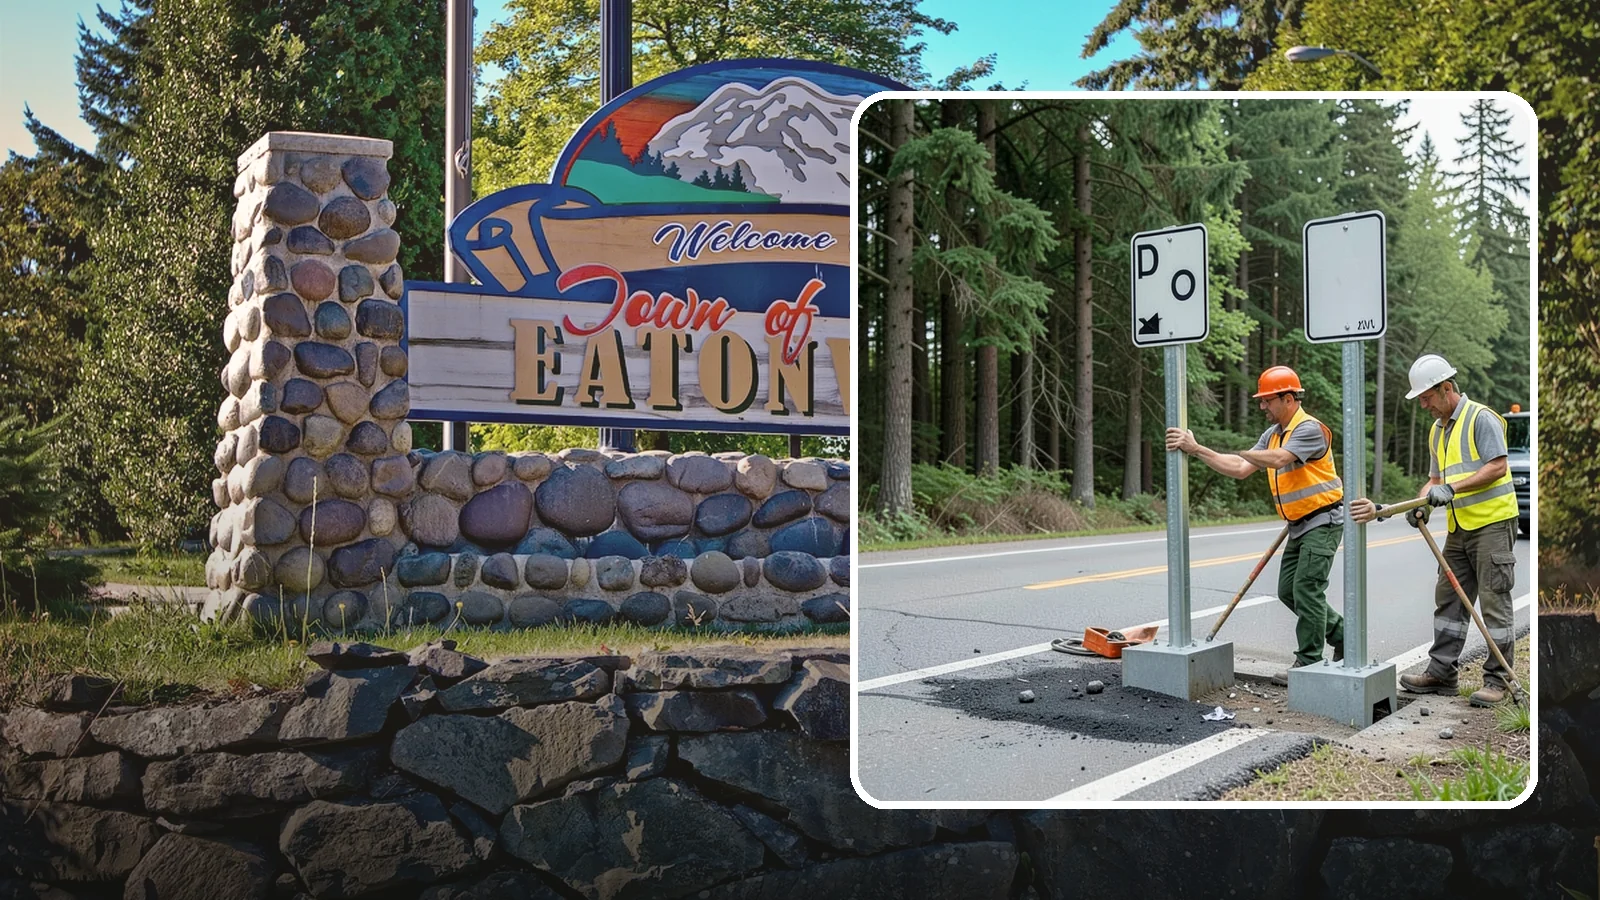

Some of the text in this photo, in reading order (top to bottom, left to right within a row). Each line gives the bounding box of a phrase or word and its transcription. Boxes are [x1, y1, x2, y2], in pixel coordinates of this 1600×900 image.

[653, 221, 838, 264] Welcome
[556, 262, 826, 365] Town of
